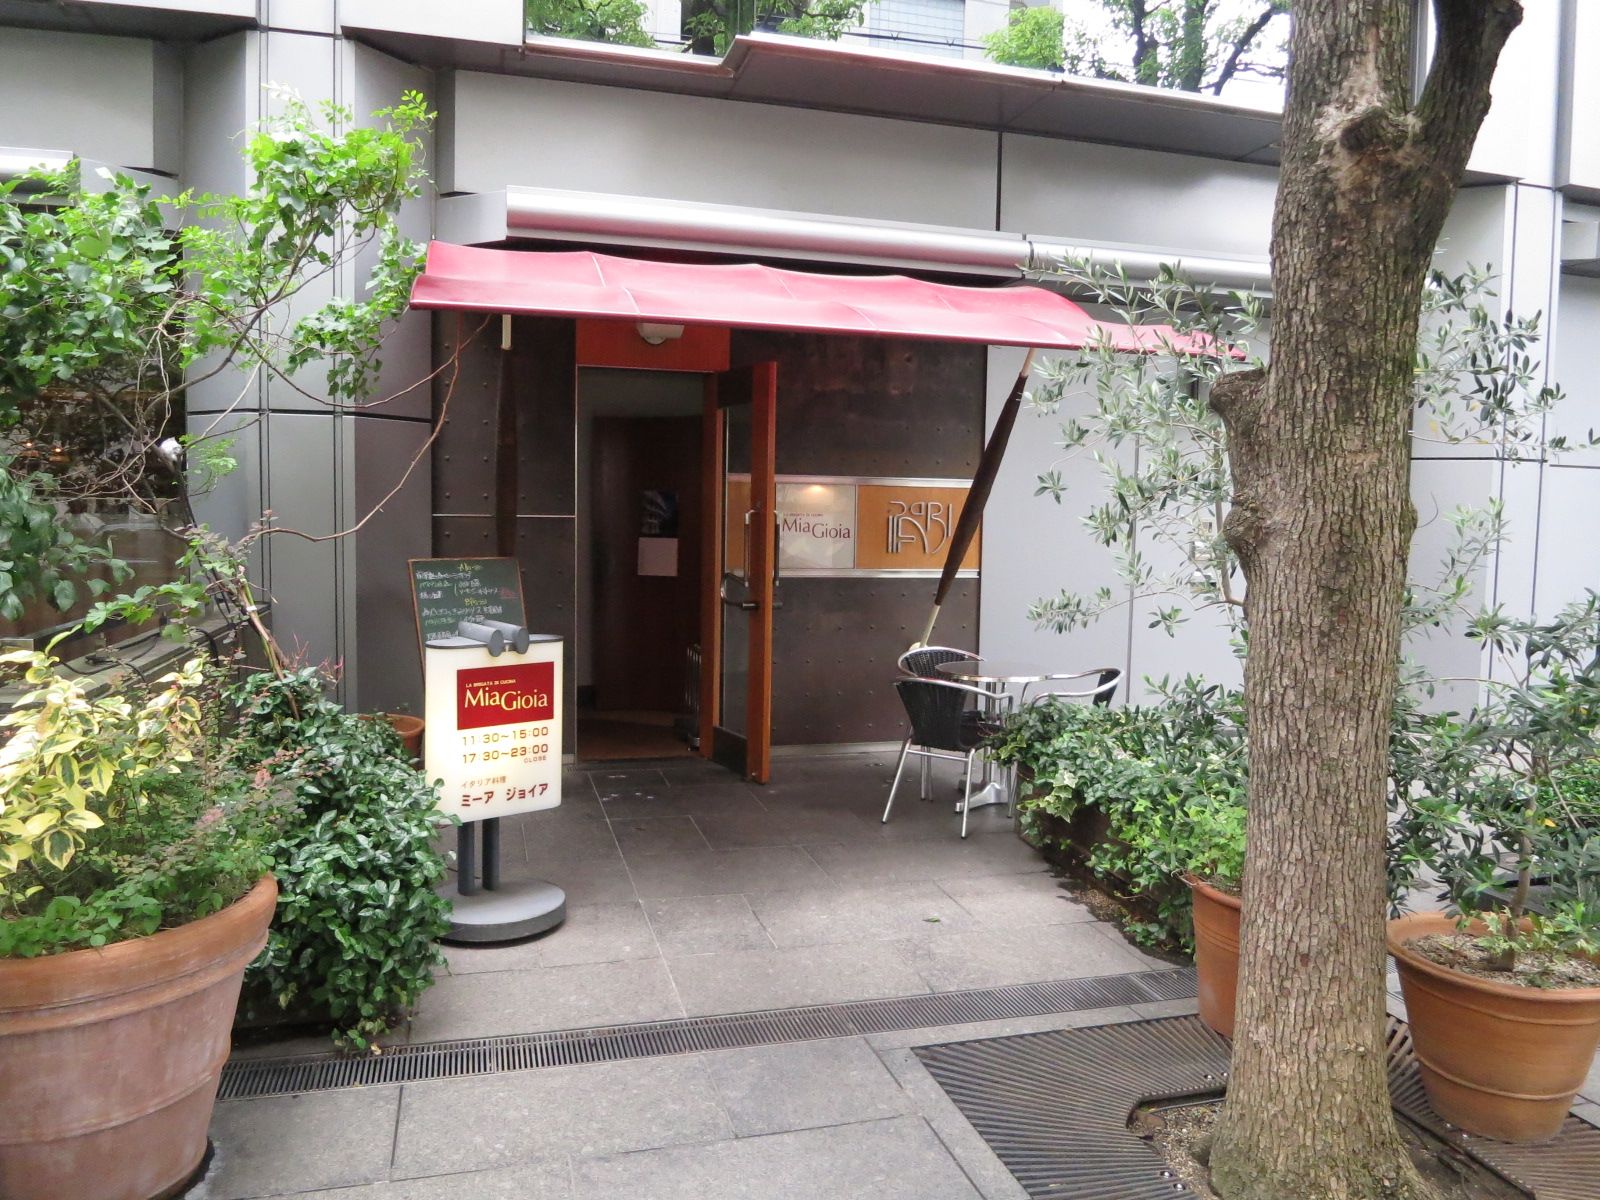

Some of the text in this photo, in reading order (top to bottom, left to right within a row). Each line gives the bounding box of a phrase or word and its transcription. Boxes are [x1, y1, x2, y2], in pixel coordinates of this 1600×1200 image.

[782, 517, 851, 539] MiaGioia
[464, 686, 548, 711] MiaGioia
[462, 726, 549, 746] 1130~15:00
[461, 775, 507, 789] イタリア料理
[461, 783, 549, 807] ミーア ジョイア
